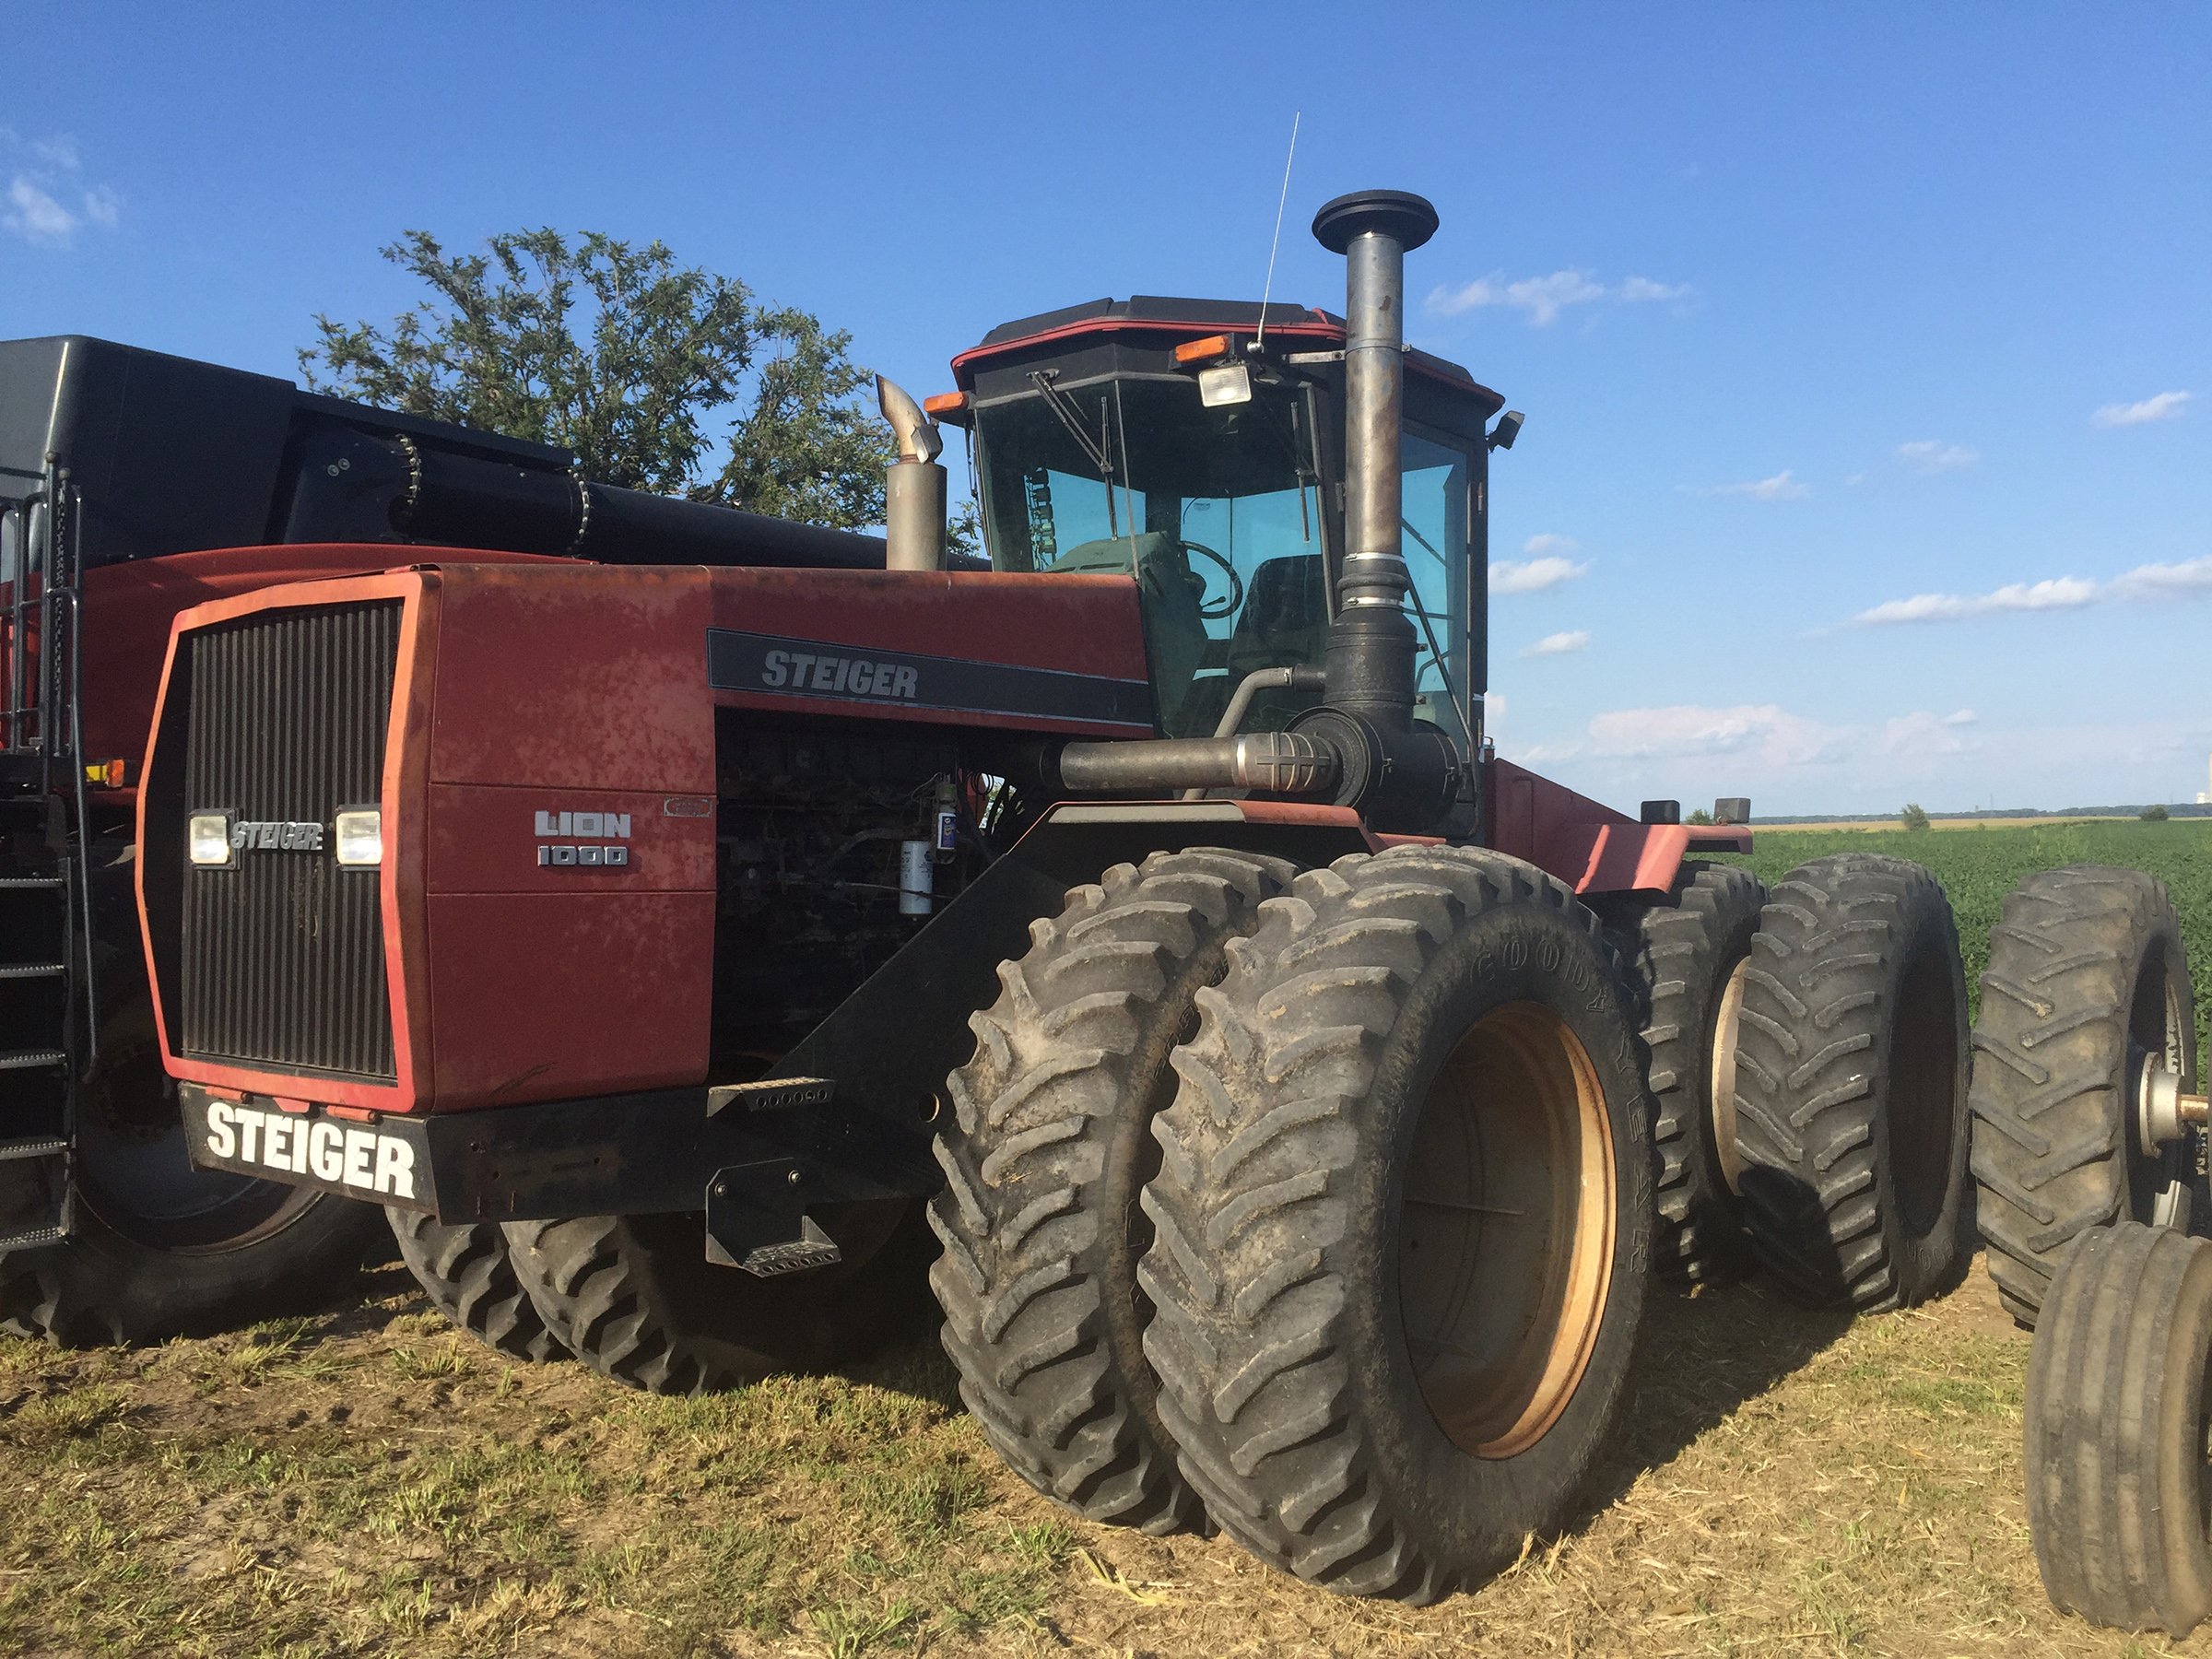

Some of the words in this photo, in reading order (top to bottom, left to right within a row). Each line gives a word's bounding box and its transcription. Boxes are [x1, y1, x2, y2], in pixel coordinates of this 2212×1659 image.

[761, 649, 919, 699] STEIGER
[230, 820, 324, 851] STEIGER
[534, 810, 631, 839] LION
[537, 845, 629, 866] 1000
[1469, 936, 1654, 1275] GOODYEAR
[206, 1100, 416, 1200] STEIGER
